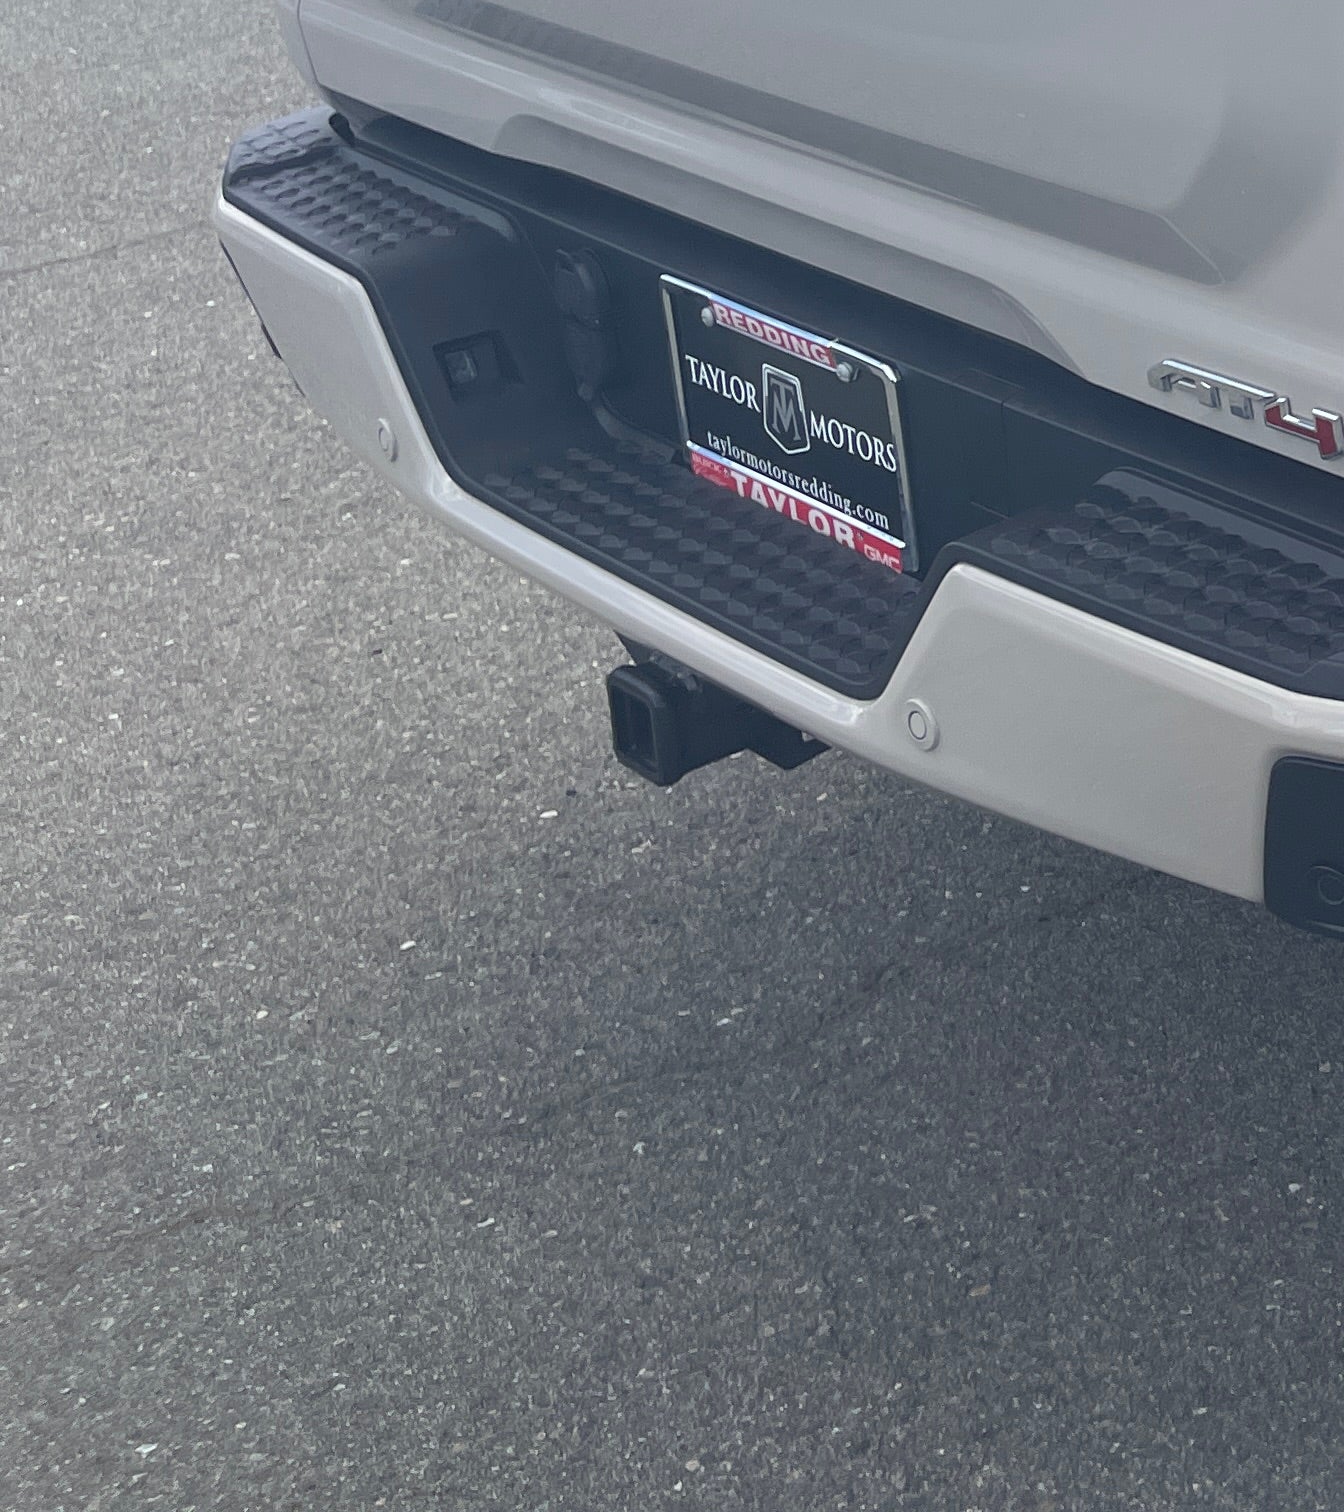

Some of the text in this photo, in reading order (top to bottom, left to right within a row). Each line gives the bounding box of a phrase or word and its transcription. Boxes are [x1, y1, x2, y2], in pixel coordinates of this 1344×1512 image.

[713, 301, 832, 366] REDDING
[685, 354, 897, 473] TAYLOR MOTORS
[707, 430, 890, 530] taylormotorsredding.com
[730, 470, 856, 549] TAYLOR
[864, 543, 901, 574] GMC
